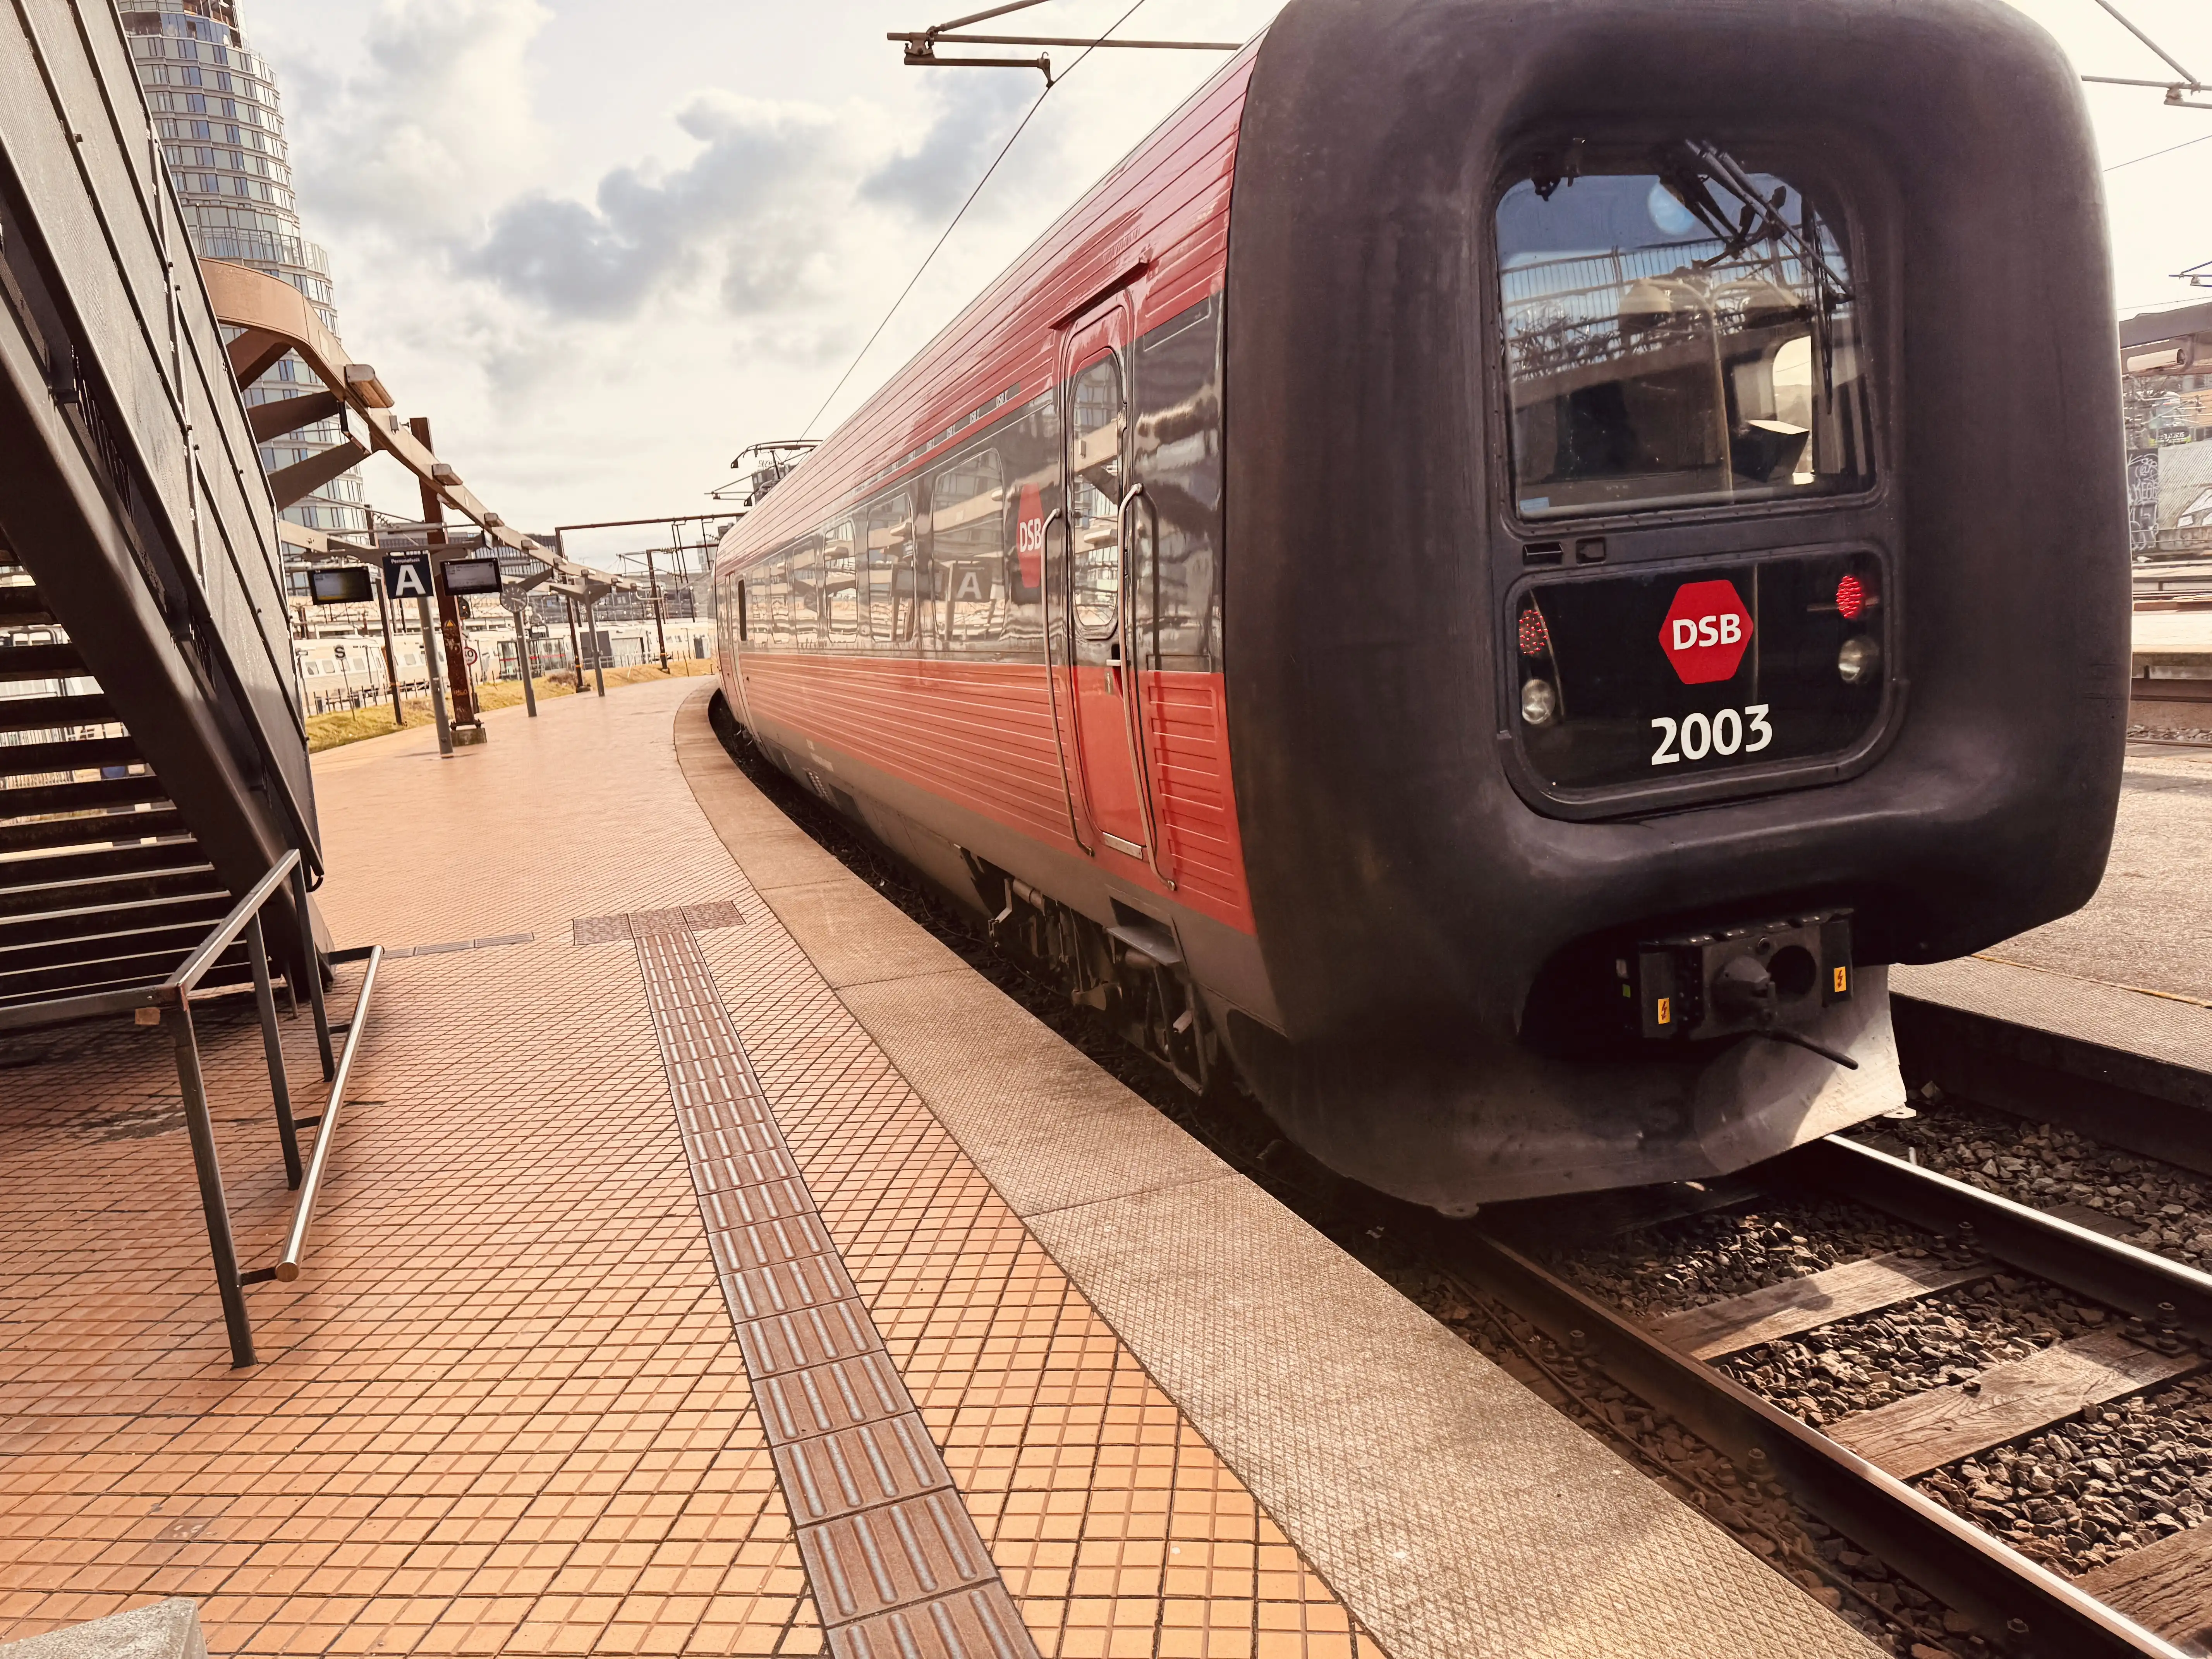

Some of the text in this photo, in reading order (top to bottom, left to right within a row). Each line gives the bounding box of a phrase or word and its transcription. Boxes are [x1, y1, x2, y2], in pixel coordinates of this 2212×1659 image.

[1020, 518, 1041, 552] DSB
[395, 564, 426, 596] A
[1673, 613, 1741, 650] DSB
[335, 646, 346, 658] S
[1651, 704, 1772, 766] 2003
